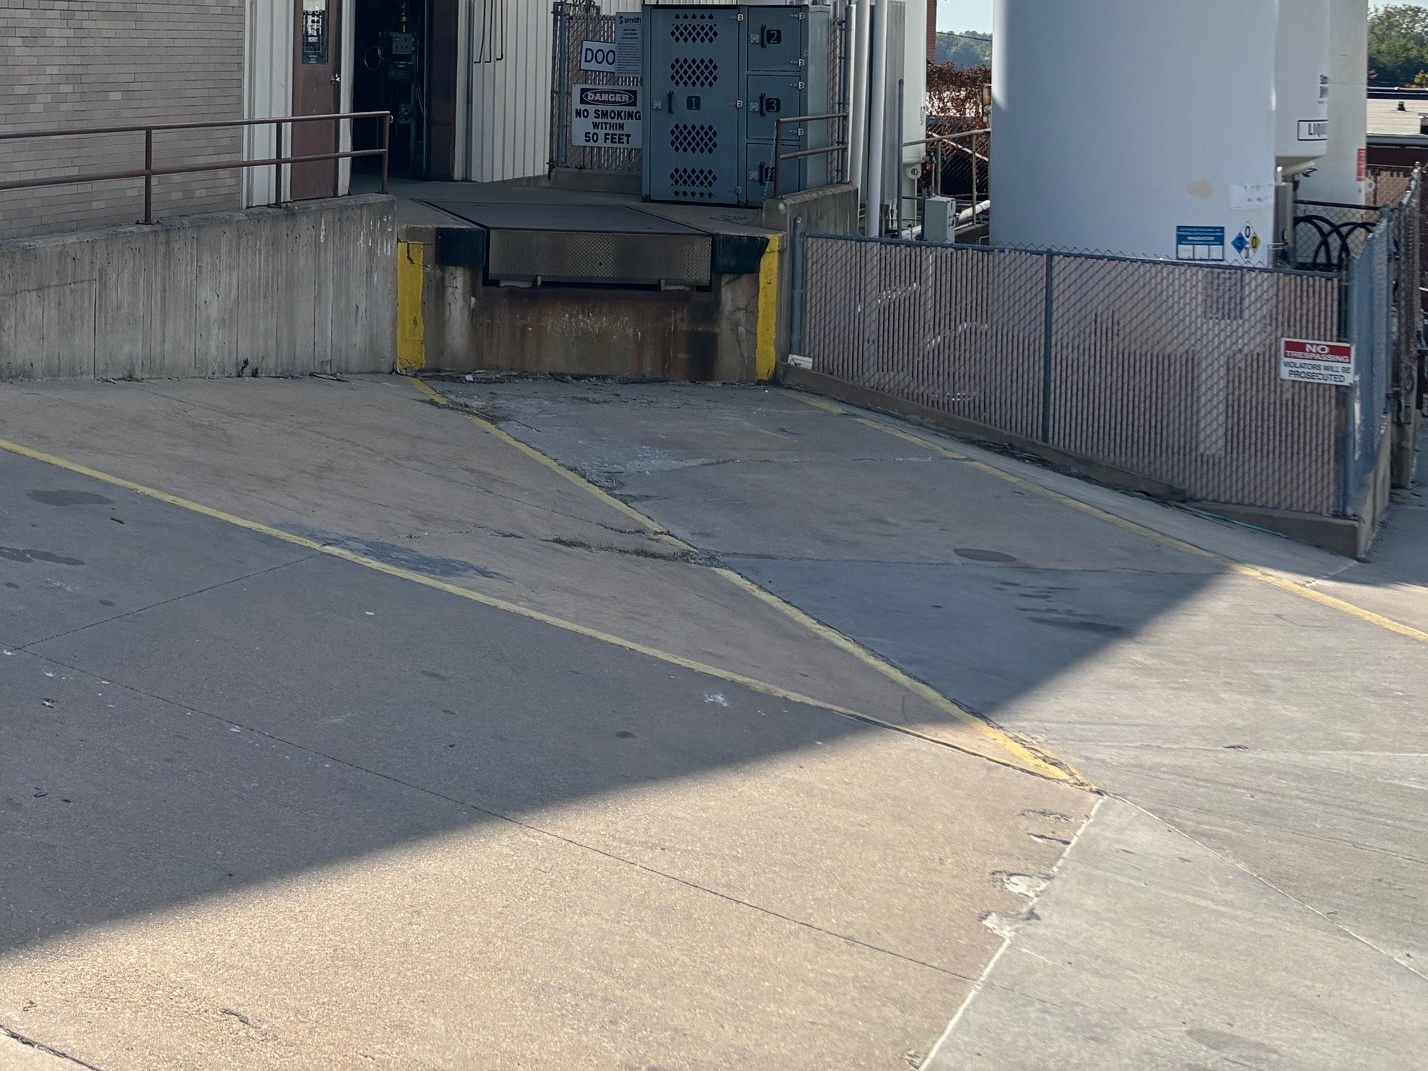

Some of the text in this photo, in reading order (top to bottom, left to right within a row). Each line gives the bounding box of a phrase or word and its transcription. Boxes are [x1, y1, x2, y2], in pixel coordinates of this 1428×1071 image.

[770, 31, 778, 43] 2
[587, 92, 630, 102] DANGER
[769, 99, 777, 111] 3
[575, 109, 642, 121] NO SMOKING
[592, 121, 625, 131] WITHIN
[584, 131, 632, 145] 50 FEET
[1305, 343, 1330, 354] NO
[1285, 350, 1349, 363] TRESPASSING
[1283, 361, 1351, 374] VIOLATORS WILL BE
[1288, 369, 1346, 383] PROSECUTED
